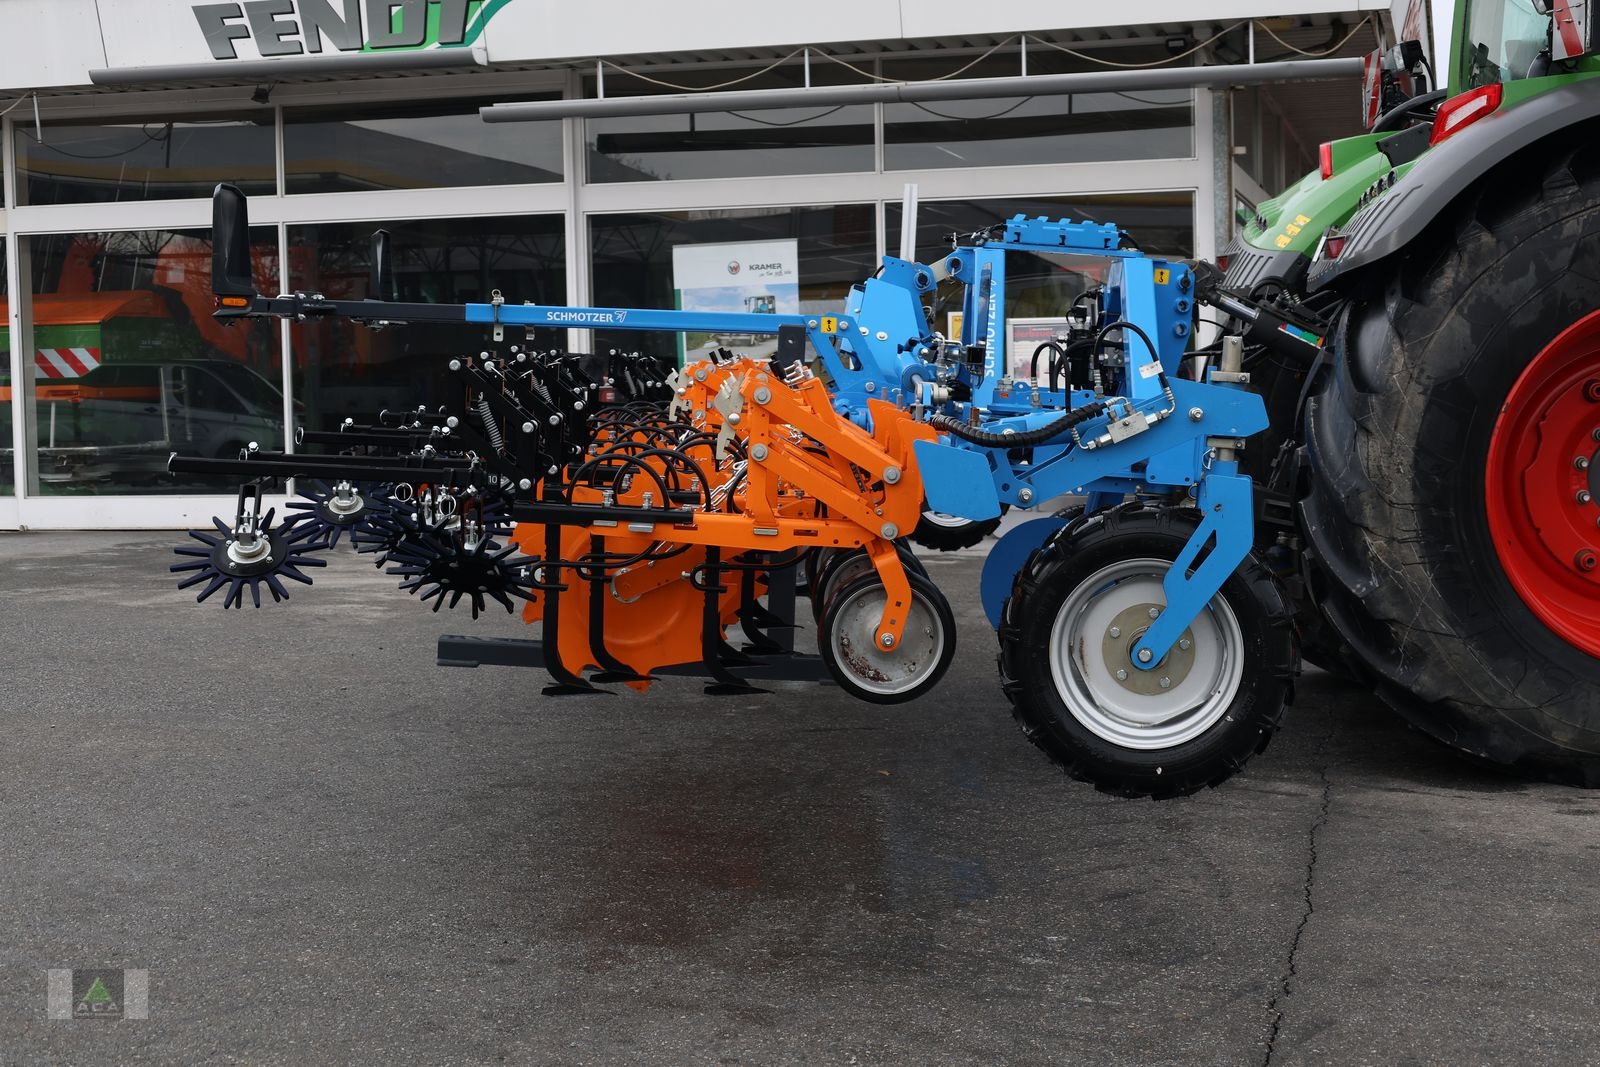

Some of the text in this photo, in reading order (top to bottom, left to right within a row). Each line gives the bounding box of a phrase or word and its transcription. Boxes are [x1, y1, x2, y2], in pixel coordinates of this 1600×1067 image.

[191, 0, 484, 60] FENDT
[749, 263, 782, 271] KRAMER
[546, 311, 614, 323] SCHMOTZER
[488, 475, 498, 484] 10
